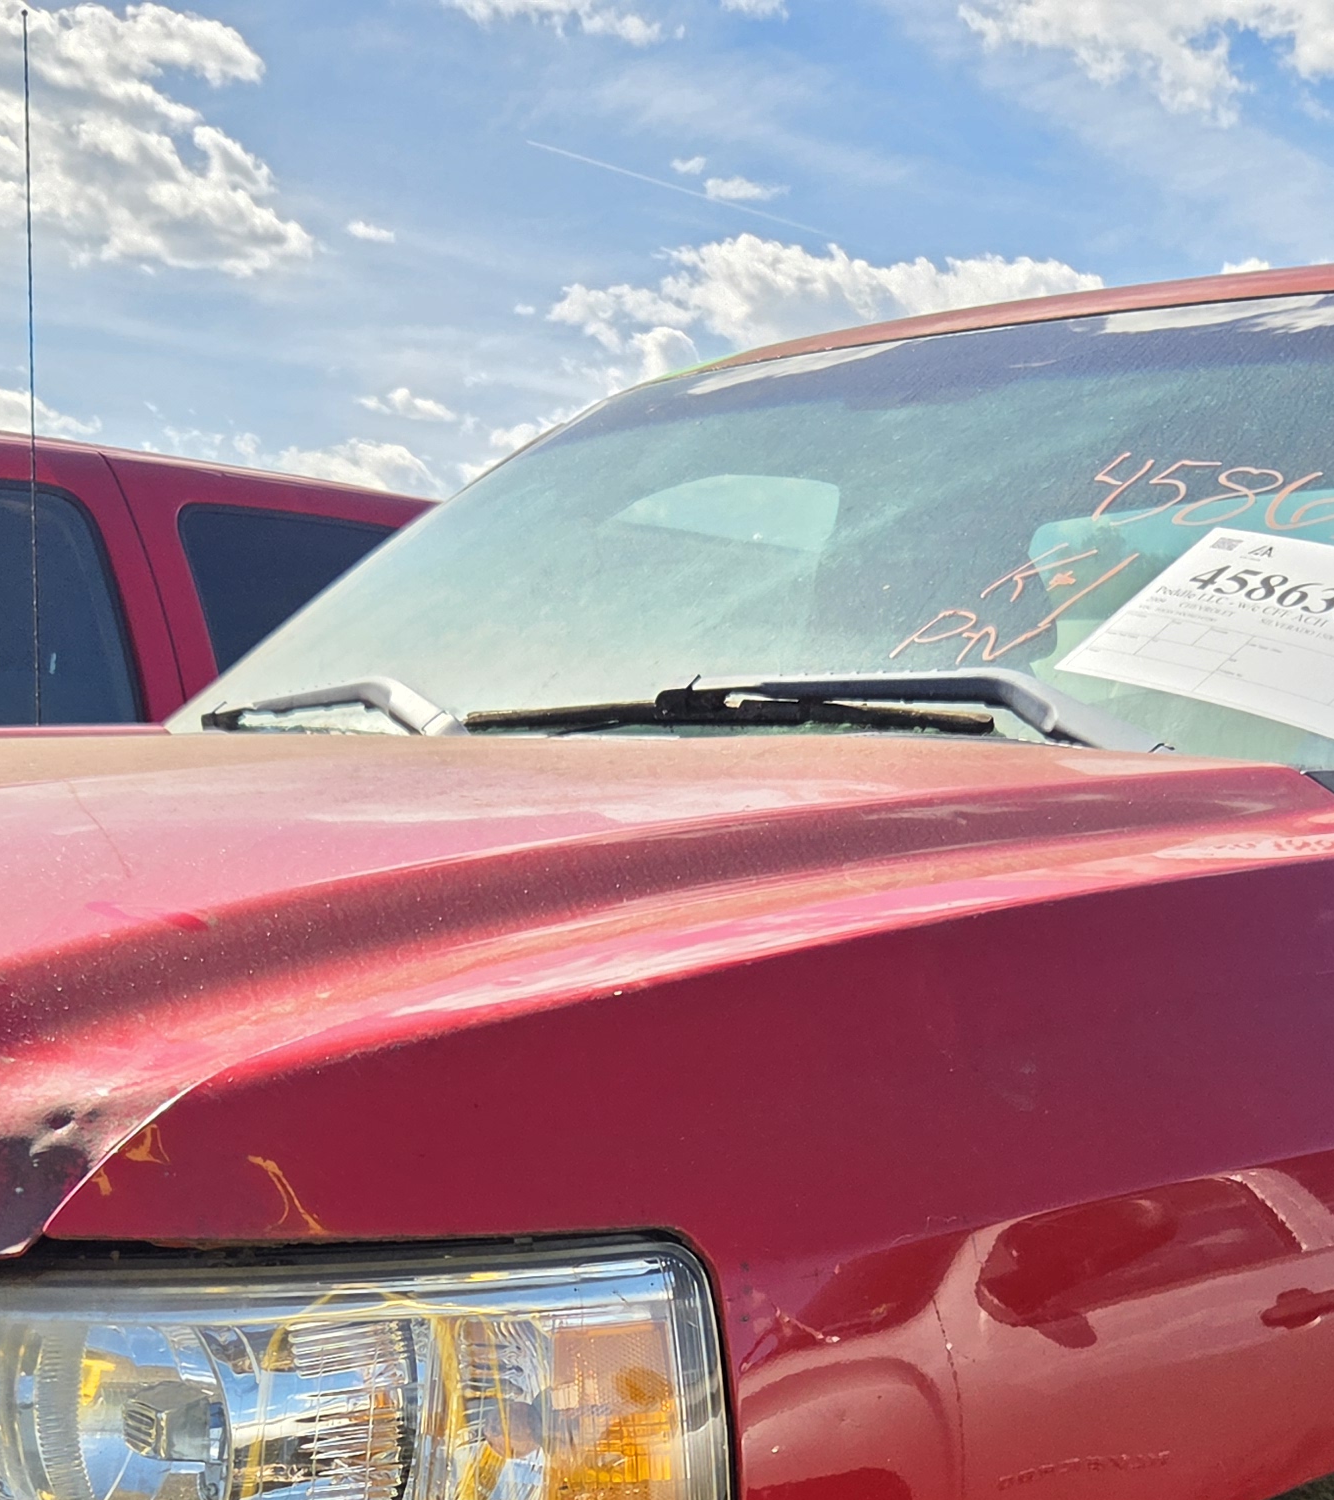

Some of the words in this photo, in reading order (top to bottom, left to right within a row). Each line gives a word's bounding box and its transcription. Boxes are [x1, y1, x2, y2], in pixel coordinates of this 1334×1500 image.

[1155, 586, 1196, 600] Peddle
[1198, 593, 1229, 605] LLC
[1292, 614, 1329, 628] ACH
[1179, 602, 1236, 617] CHEVROLET
[1260, 617, 1316, 637] SILVERADO
